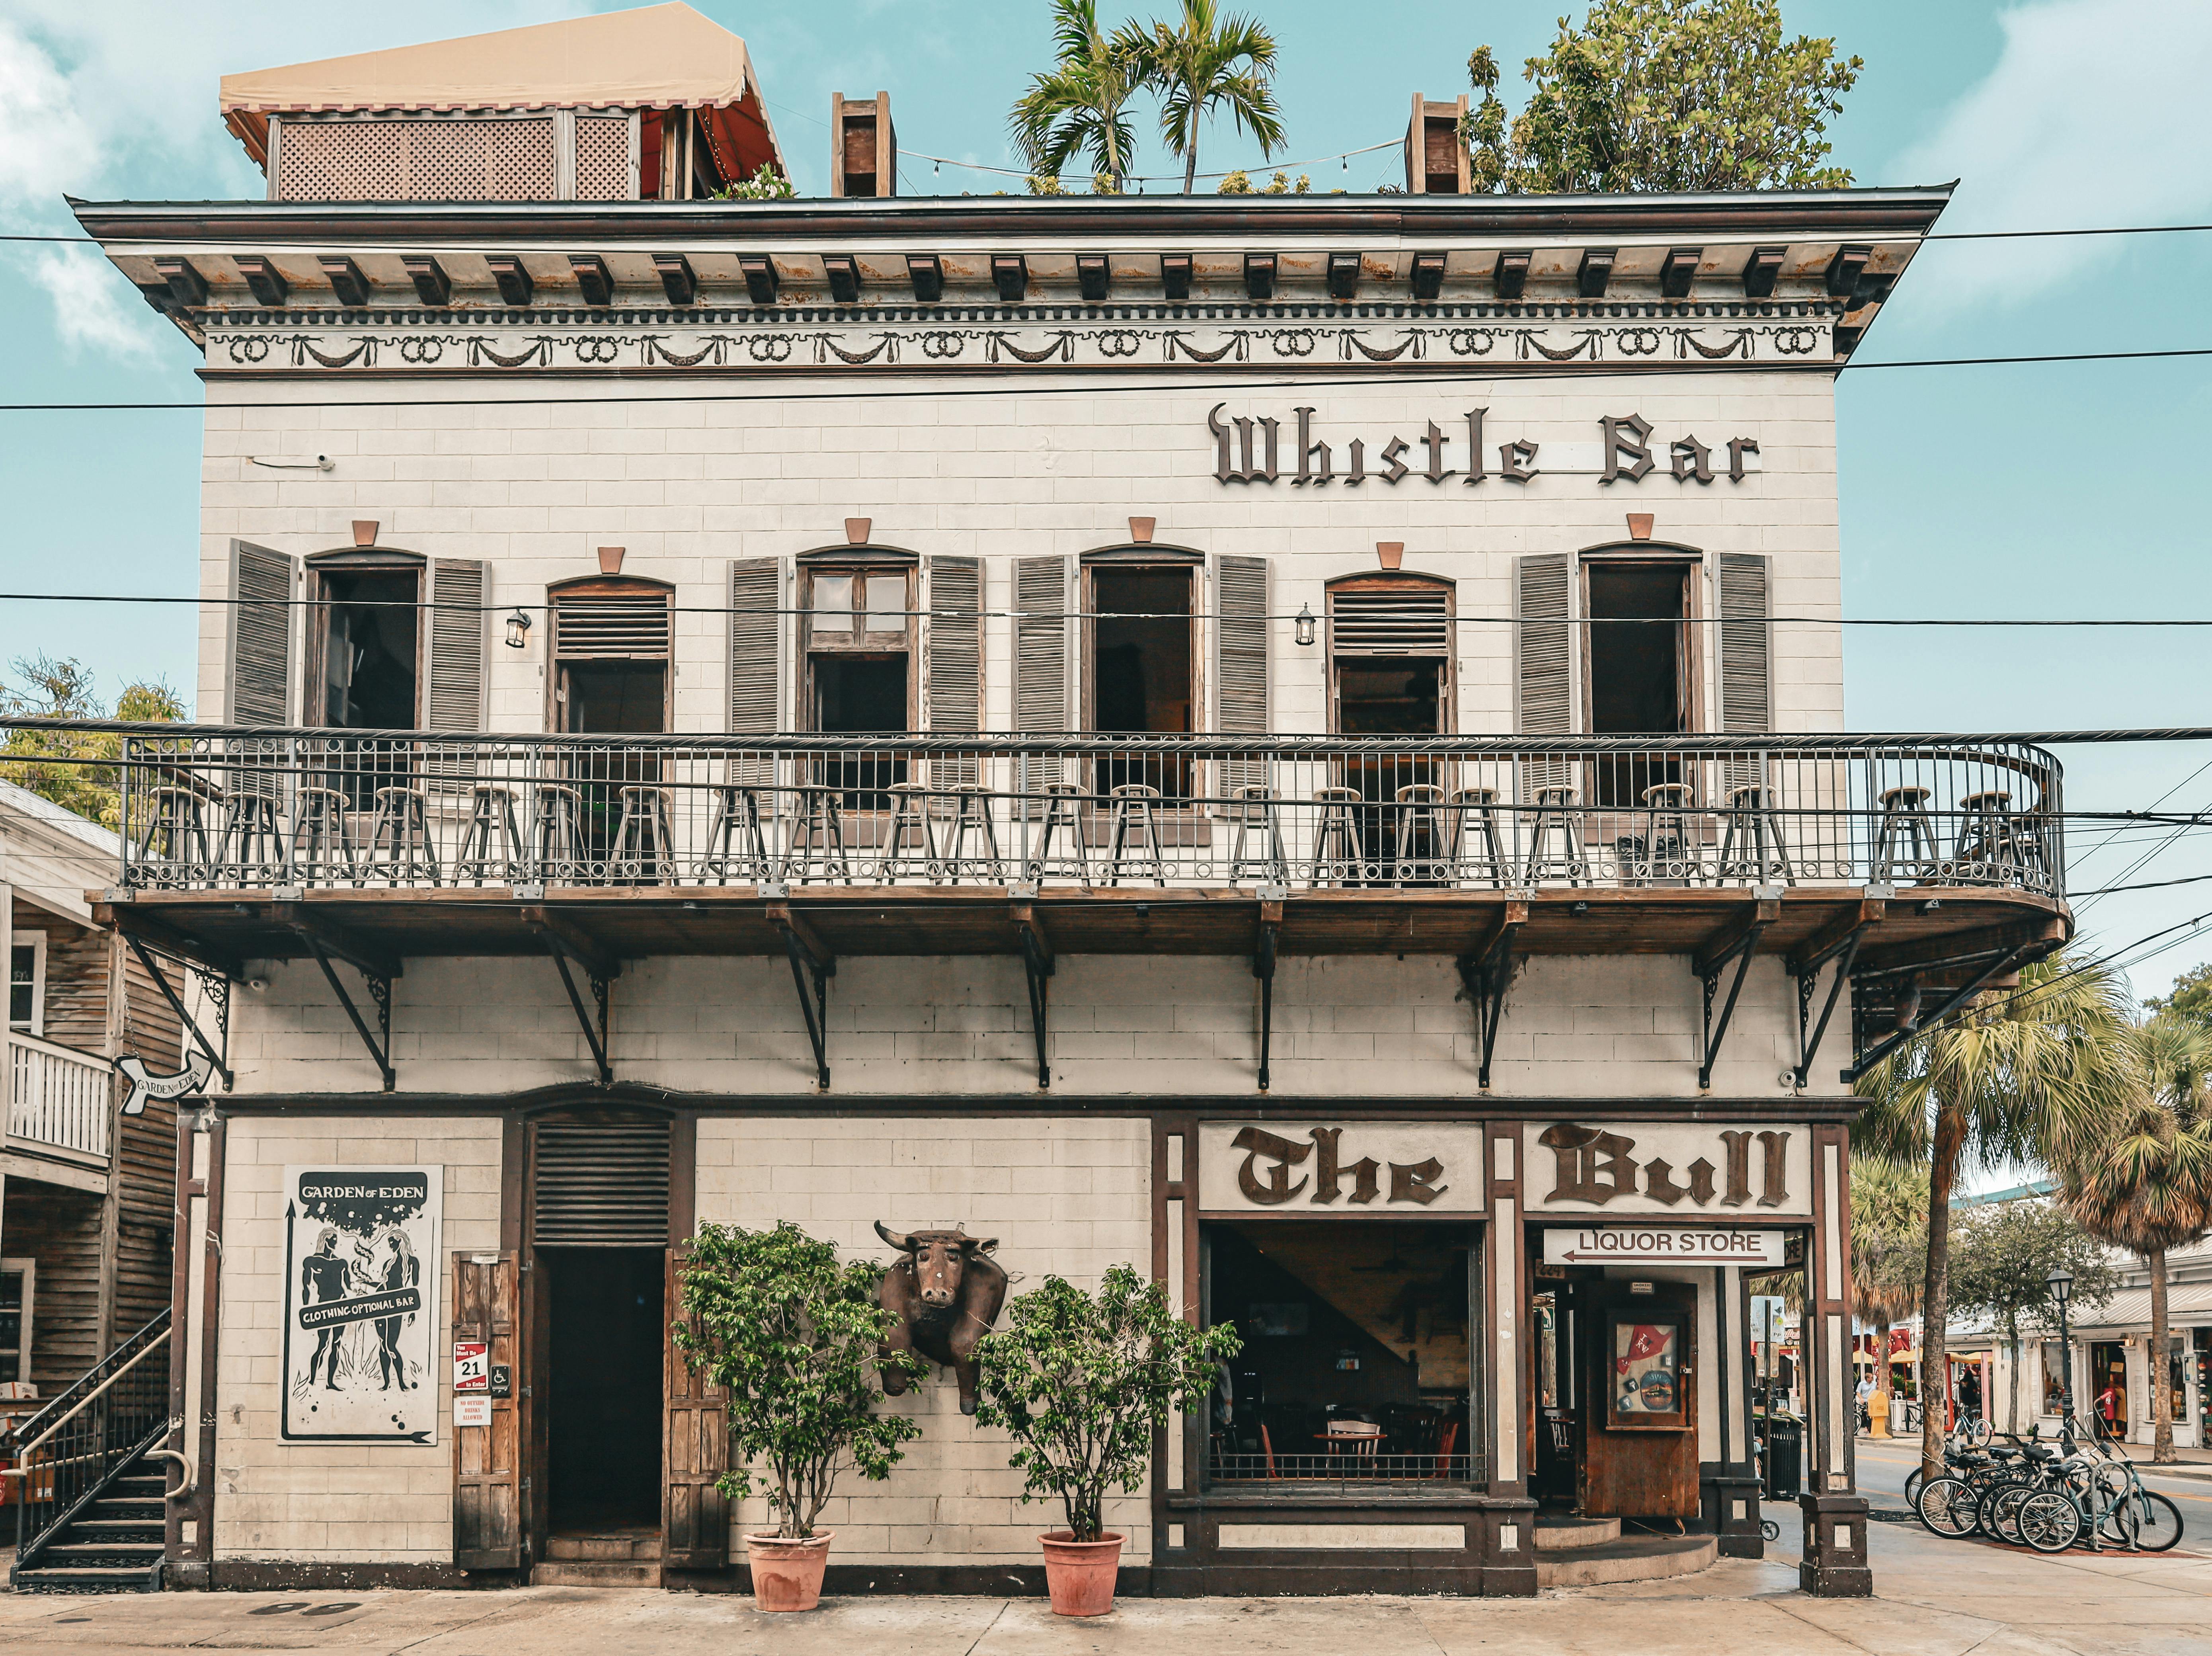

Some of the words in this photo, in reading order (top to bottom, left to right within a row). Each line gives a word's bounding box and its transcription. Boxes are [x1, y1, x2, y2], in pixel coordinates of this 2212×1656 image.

[1208, 402, 1539, 486] Whistle
[1597, 412, 1760, 486] Bar
[137, 1080, 174, 1094] GARDEN
[179, 1068, 201, 1089] EDEN
[1230, 1126, 1449, 1205] The
[1538, 1124, 1793, 1208] Bull
[302, 1185, 365, 1198] GARDEN
[365, 1189, 377, 1198] OF
[379, 1186, 424, 1198] EDEN
[1580, 1233, 1672, 1251] LIQUOR
[1679, 1234, 1761, 1252] STORE
[303, 1305, 351, 1323] CLOTHING
[351, 1300, 395, 1315] OPTIONAL
[396, 1297, 414, 1307] BAR
[462, 1362, 480, 1375] 21
